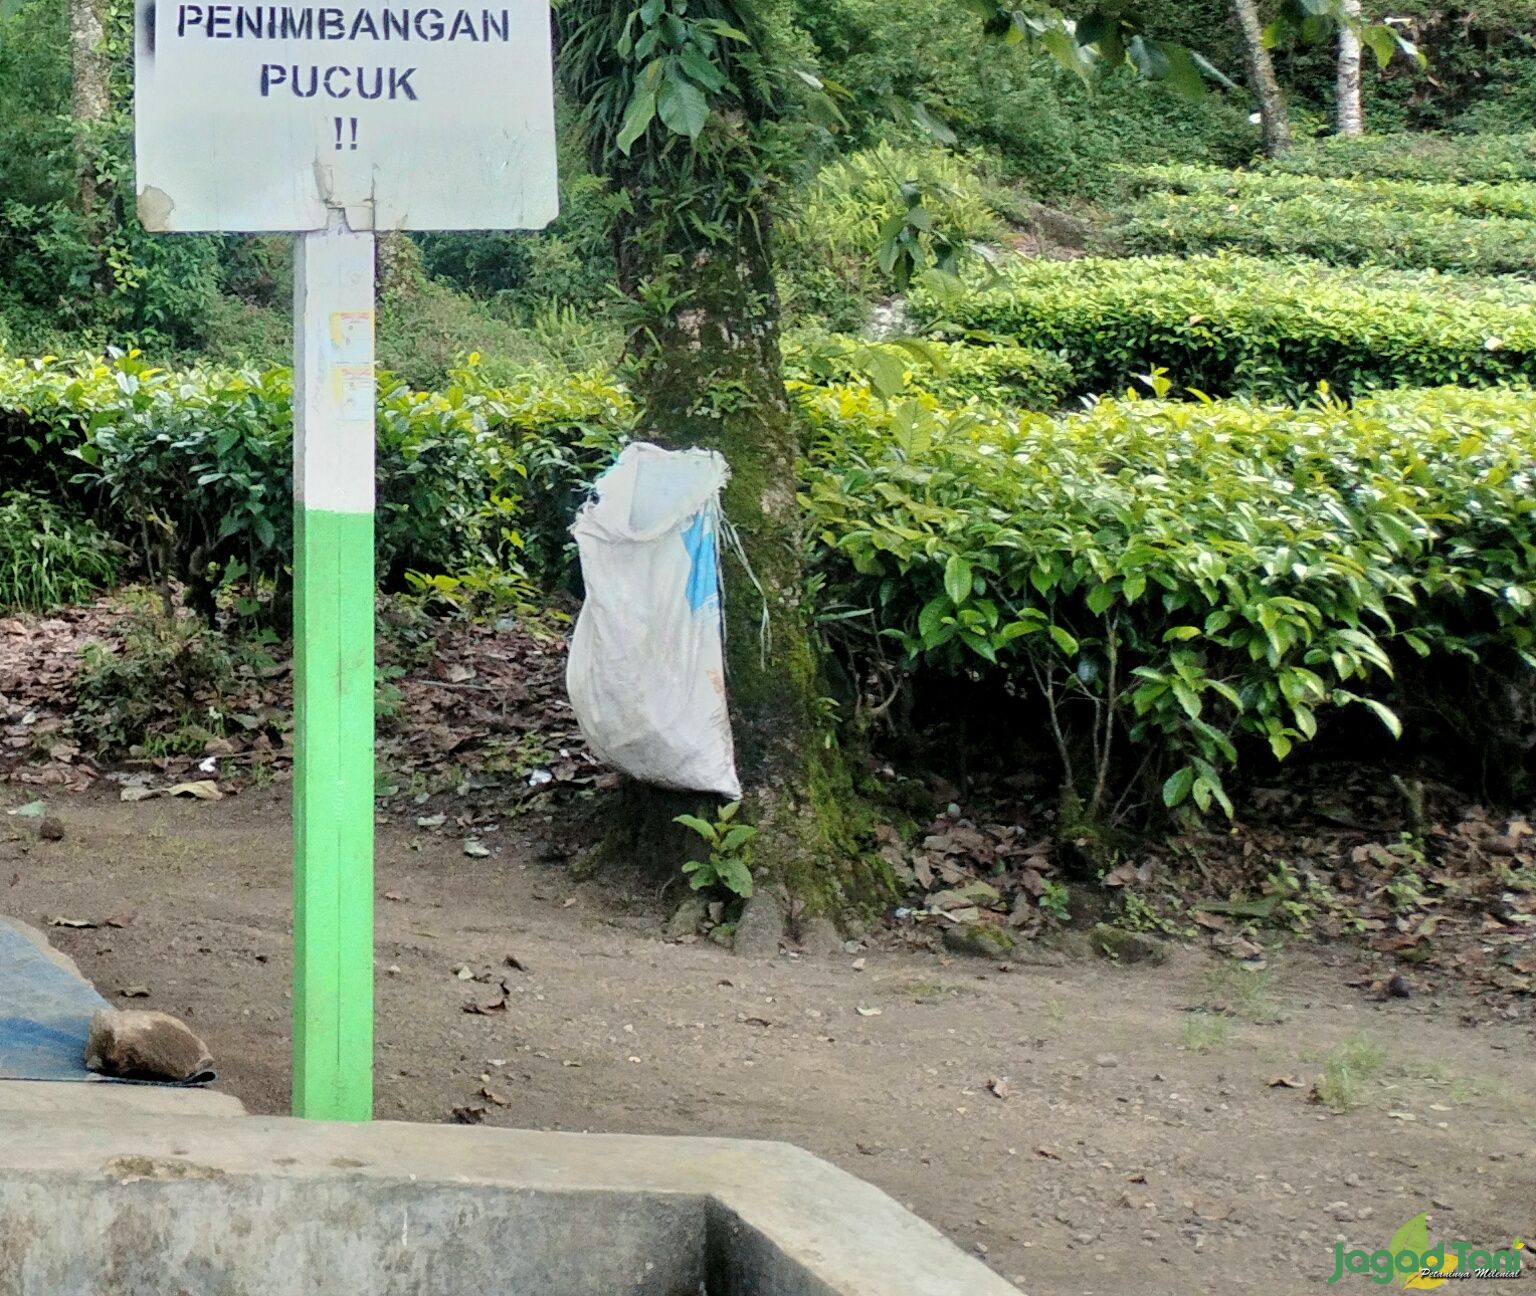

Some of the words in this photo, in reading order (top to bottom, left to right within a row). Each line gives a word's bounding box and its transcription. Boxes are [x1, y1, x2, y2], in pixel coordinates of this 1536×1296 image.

[177, 3, 511, 43] PENIMBANGAN
[259, 63, 419, 102] PUCUK
[334, 116, 359, 151] !!
